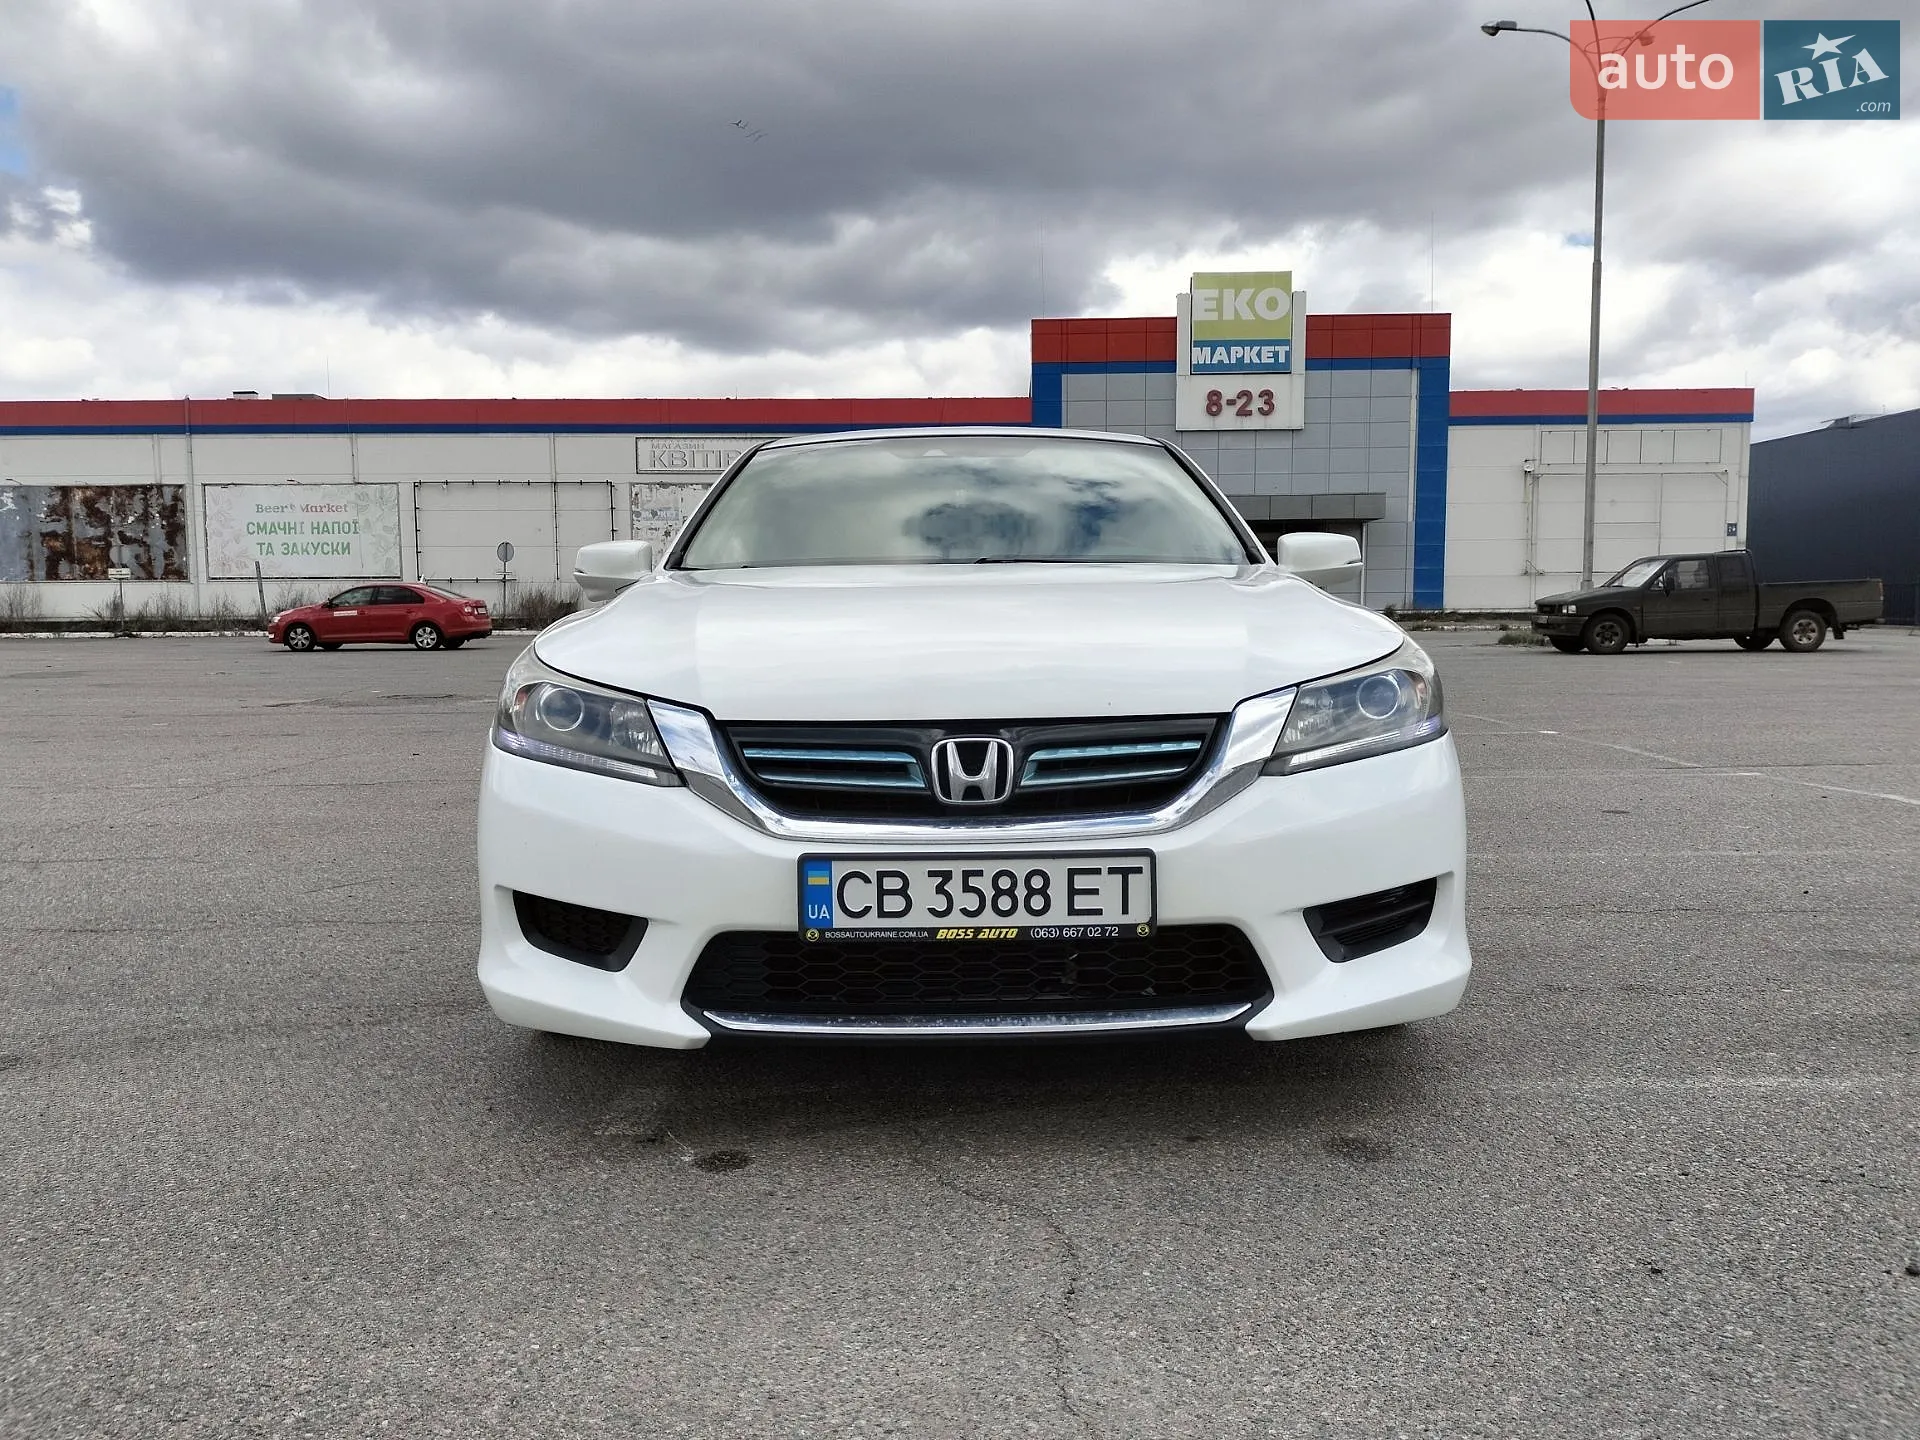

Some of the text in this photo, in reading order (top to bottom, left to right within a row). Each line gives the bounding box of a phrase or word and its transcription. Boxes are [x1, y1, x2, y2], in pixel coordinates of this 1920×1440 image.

[1192, 345, 1290, 365] МАРКЕТ
[1206, 389, 1275, 417] 8-23
[300, 503, 349, 514] Market
[246, 519, 360, 535] СМАЧНІ НАПОЇ
[256, 541, 352, 556] ТА ЗАКУСКИ
[836, 866, 1144, 919] CB 3588 ET
[808, 904, 831, 919] UA
[825, 926, 1119, 940] BOSSAUTOUKRAINE.COM.UA BOSS AUTO (063) 667 02 72
